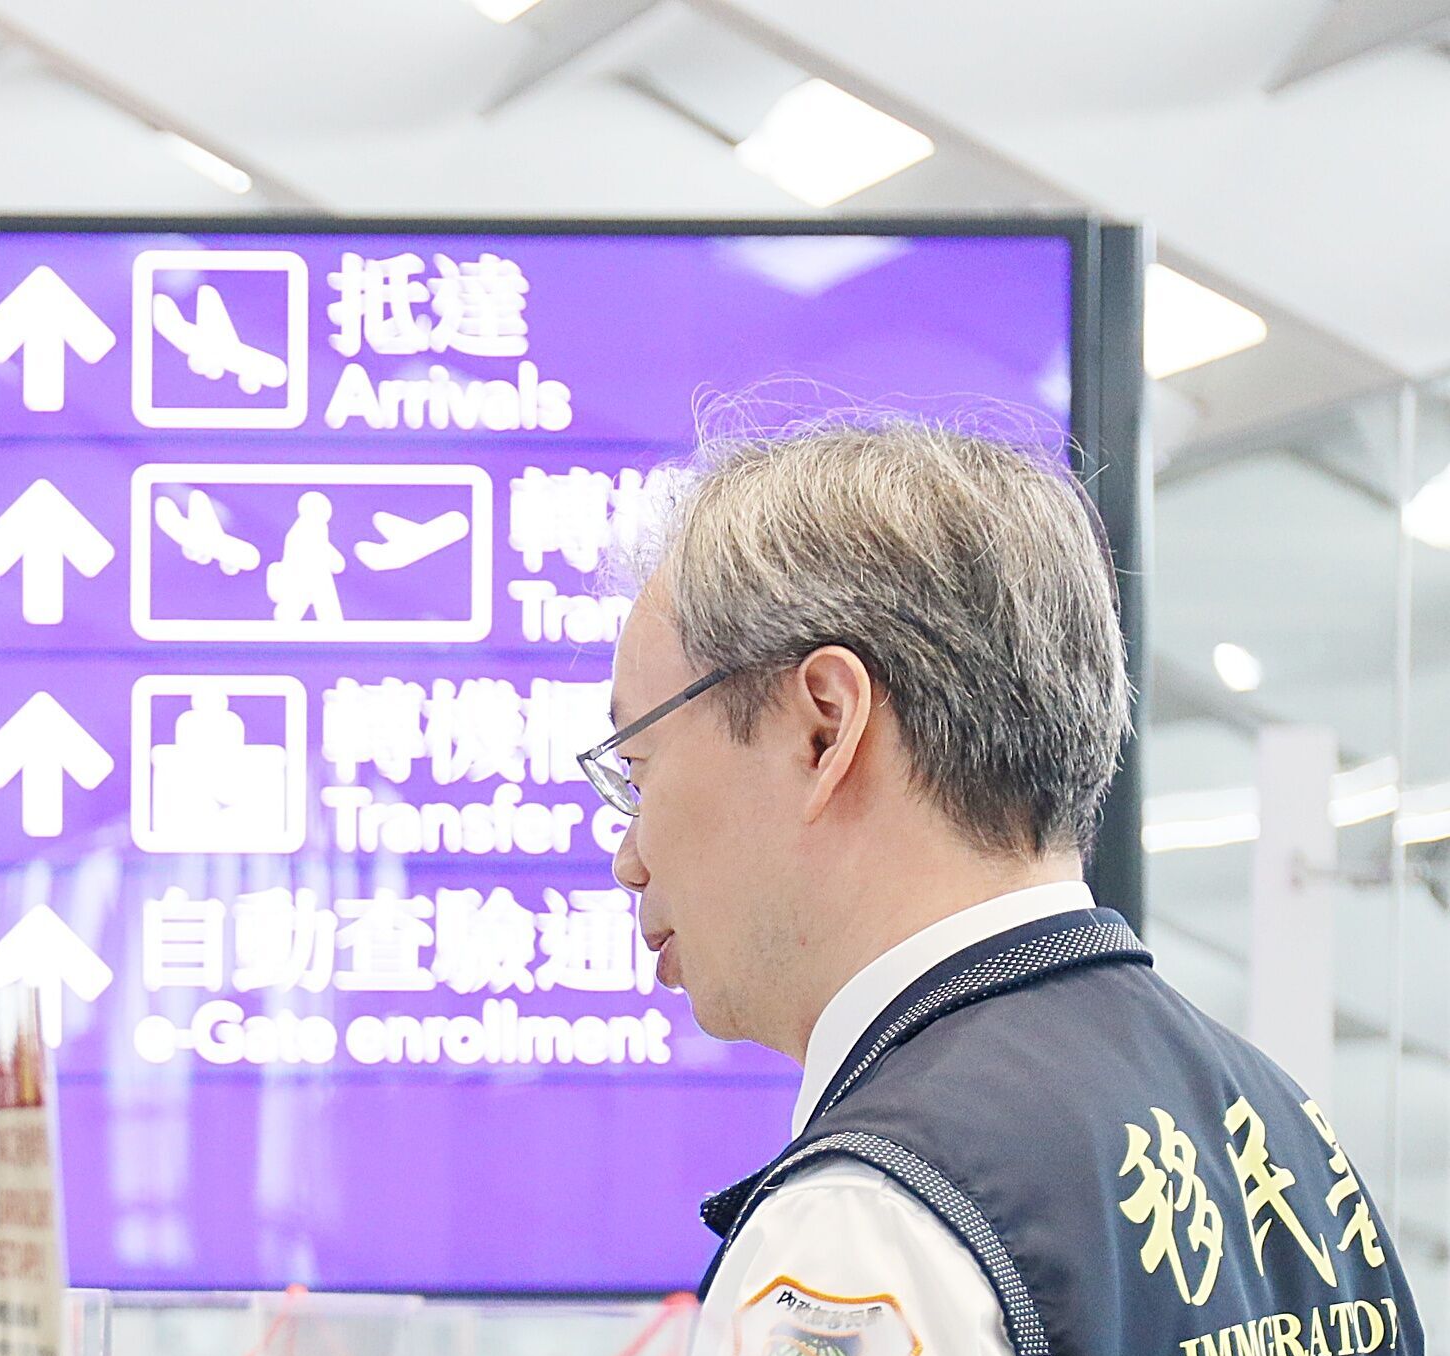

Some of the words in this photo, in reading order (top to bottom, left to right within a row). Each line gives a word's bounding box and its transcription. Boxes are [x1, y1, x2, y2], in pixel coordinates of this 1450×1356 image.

[327, 251, 530, 357] 抵達
[324, 361, 574, 432] Arrivals
[508, 580, 635, 643] Tran
[320, 782, 585, 854] Transfer
[591, 802, 635, 854] c
[142, 885, 657, 995] 自動查驗通
[133, 1000, 338, 1064] e-Gate
[345, 997, 672, 1064] enrollment
